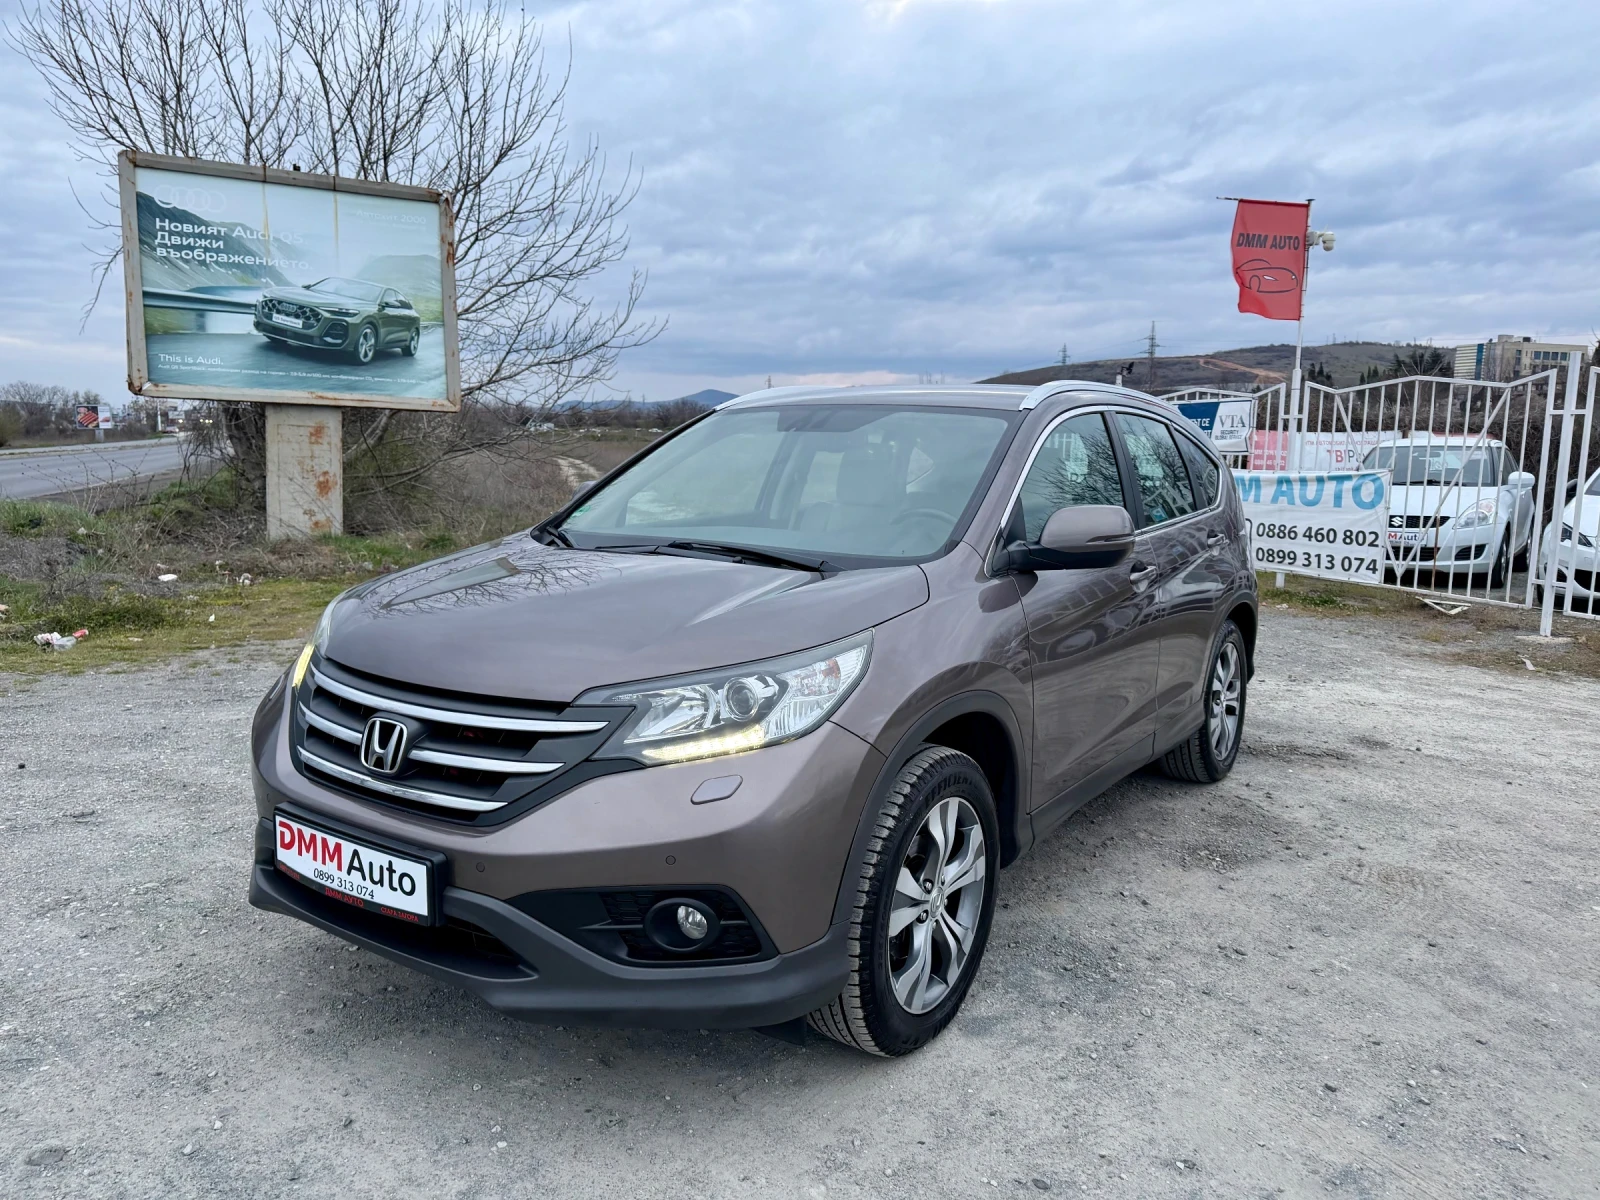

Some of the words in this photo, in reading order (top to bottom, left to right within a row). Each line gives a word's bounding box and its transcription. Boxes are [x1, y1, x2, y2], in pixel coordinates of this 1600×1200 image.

[154, 231, 224, 249] Движи
[155, 217, 227, 236] Новият
[231, 226, 274, 241] Audi
[1236, 233, 1268, 249] DMM
[1270, 235, 1300, 251] AUTO
[158, 353, 181, 363] This
[184, 355, 194, 364] is
[196, 355, 224, 365] Audi.
[1219, 414, 1247, 428] VTA
[1270, 473, 1384, 510] AUTO
[1256, 522, 1298, 540] 0886
[1302, 526, 1337, 544] 460
[1342, 529, 1379, 548] 802
[1255, 547, 1297, 565] 0899
[1302, 552, 1335, 570] 313
[1341, 556, 1378, 575] 074
[313, 867, 335, 885] 0899
[337, 876, 354, 892] 313
[356, 884, 375, 900] 074
